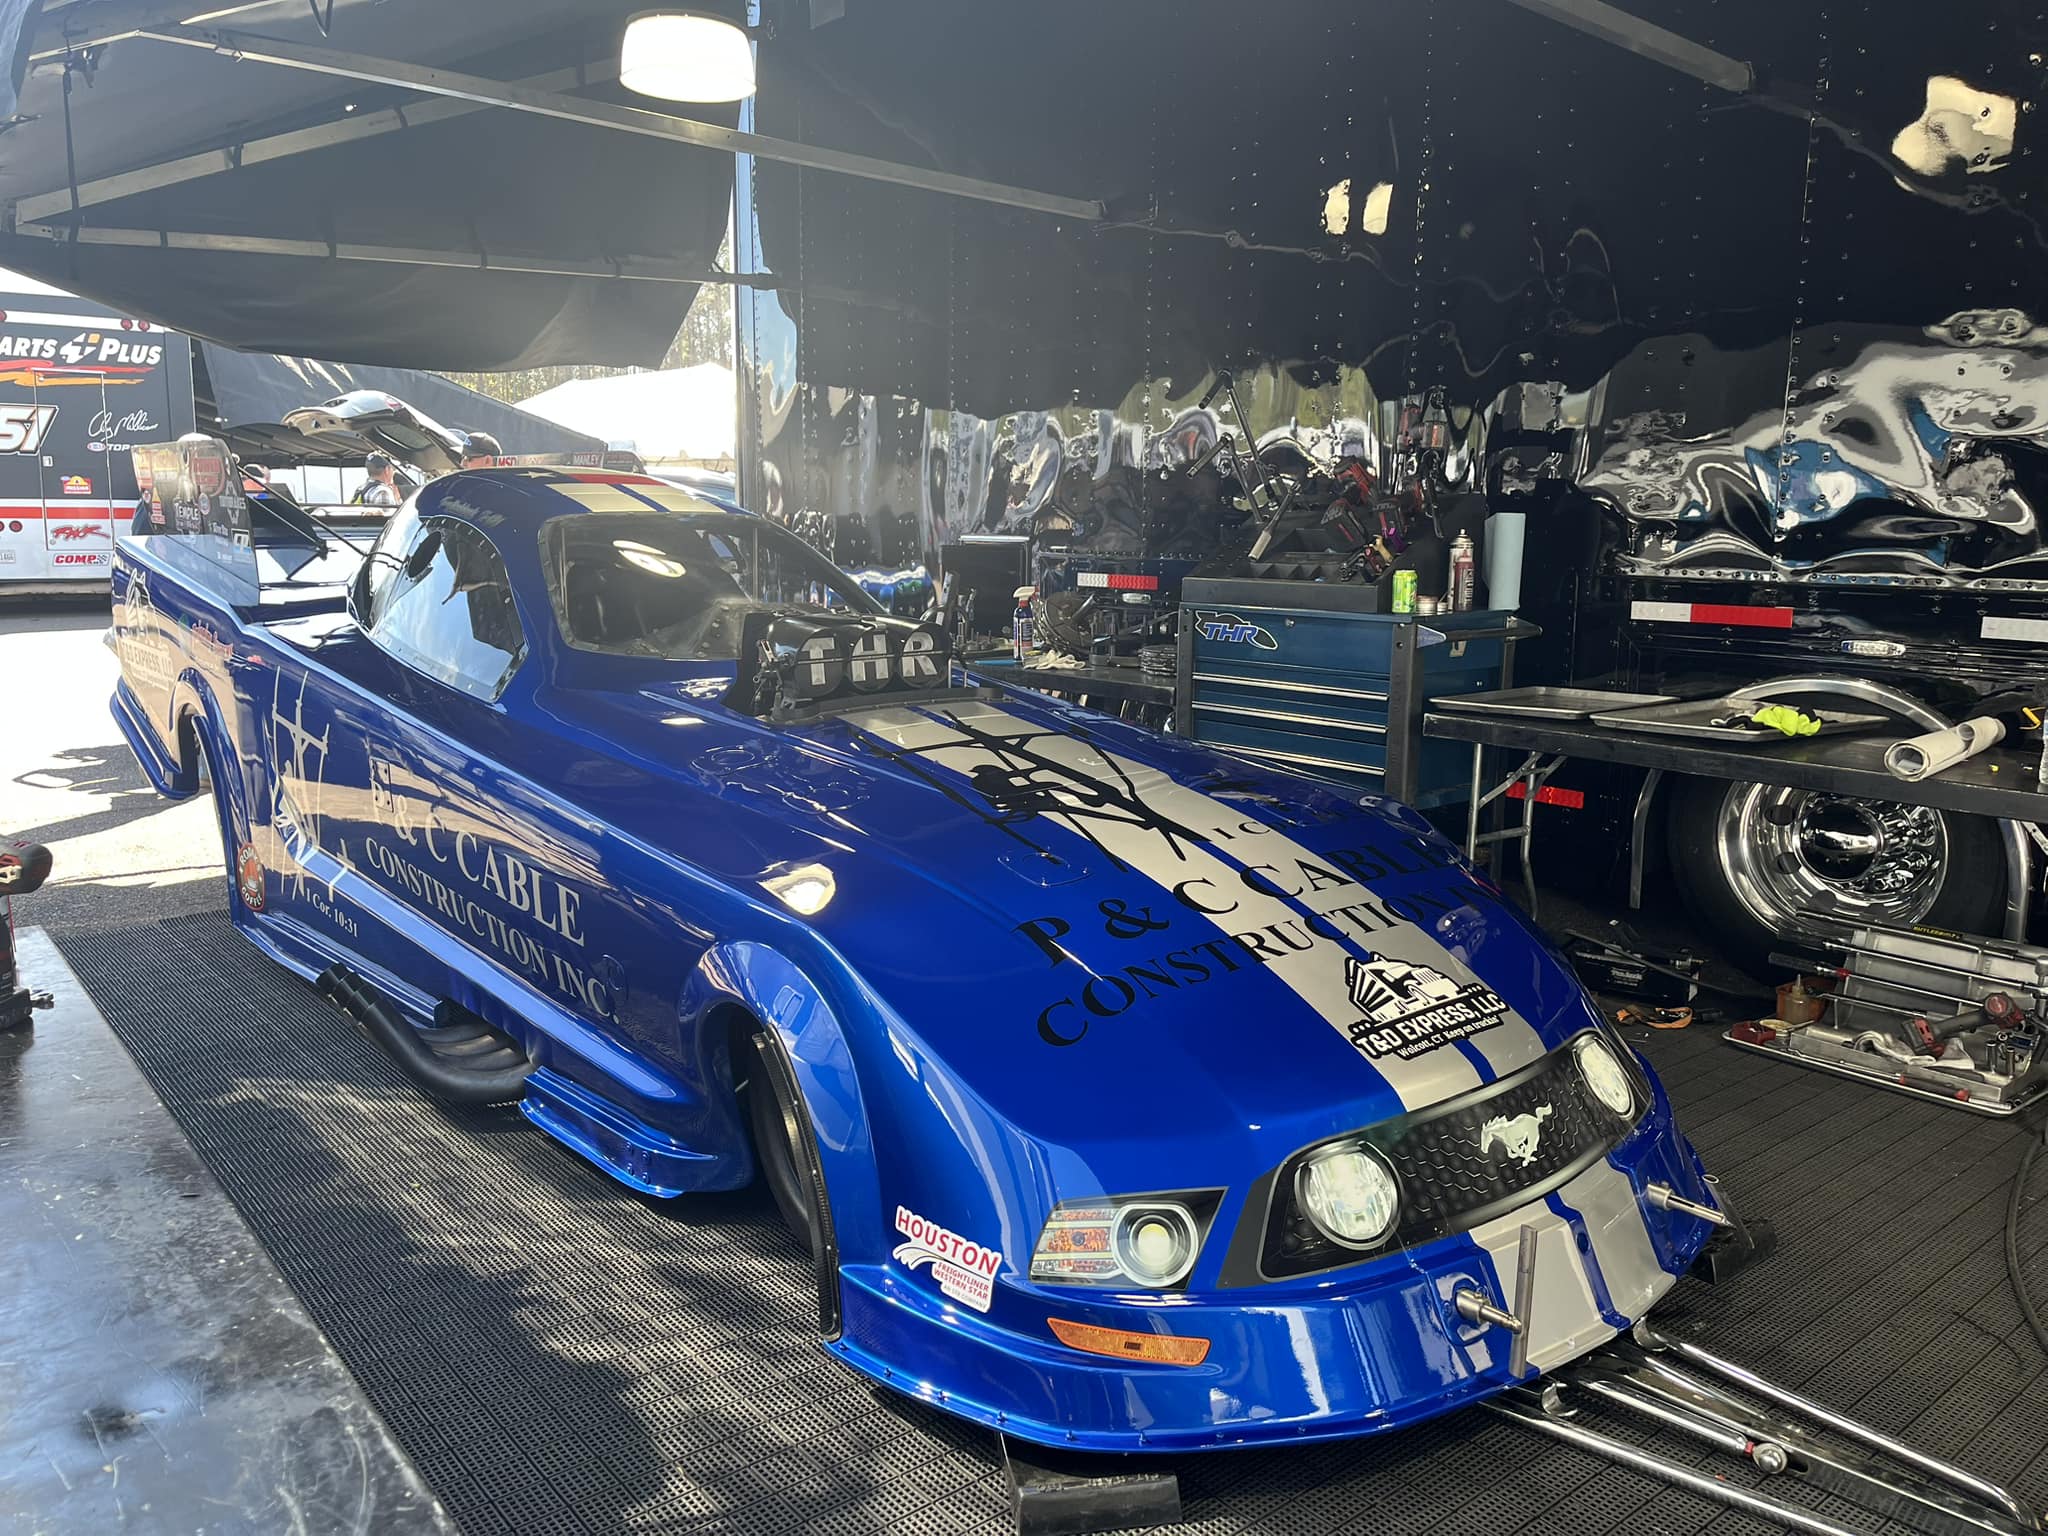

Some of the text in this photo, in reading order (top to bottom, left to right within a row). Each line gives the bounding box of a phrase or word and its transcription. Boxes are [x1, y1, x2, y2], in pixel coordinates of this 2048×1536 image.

[98, 338, 162, 365] PLUS
[0, 406, 56, 454] 51
[107, 443, 131, 452] TOP
[55, 554, 97, 564] COMP
[1203, 621, 1260, 643] THR
[801, 631, 938, 686] THR
[395, 796, 417, 847] &
[425, 811, 448, 864] C
[456, 831, 585, 947] CABLE
[313, 892, 332, 918] Cor.
[334, 908, 358, 938] 10:31
[1010, 839, 1452, 967] P & C CABLE
[365, 837, 620, 1024] CONSTRUCTION INC.
[1037, 891, 1453, 1047] CONSTRUCTION
[1356, 993, 1507, 1056] T&D EXPRESS, LLC
[1432, 1033, 1445, 1044] CT
[1442, 1028, 1464, 1041] Keep
[897, 1209, 999, 1275] HOUSTON
[934, 1269, 967, 1290] WESTERN
[968, 1286, 988, 1300] STAR
[938, 1262, 989, 1292] FREIGHTLINER
